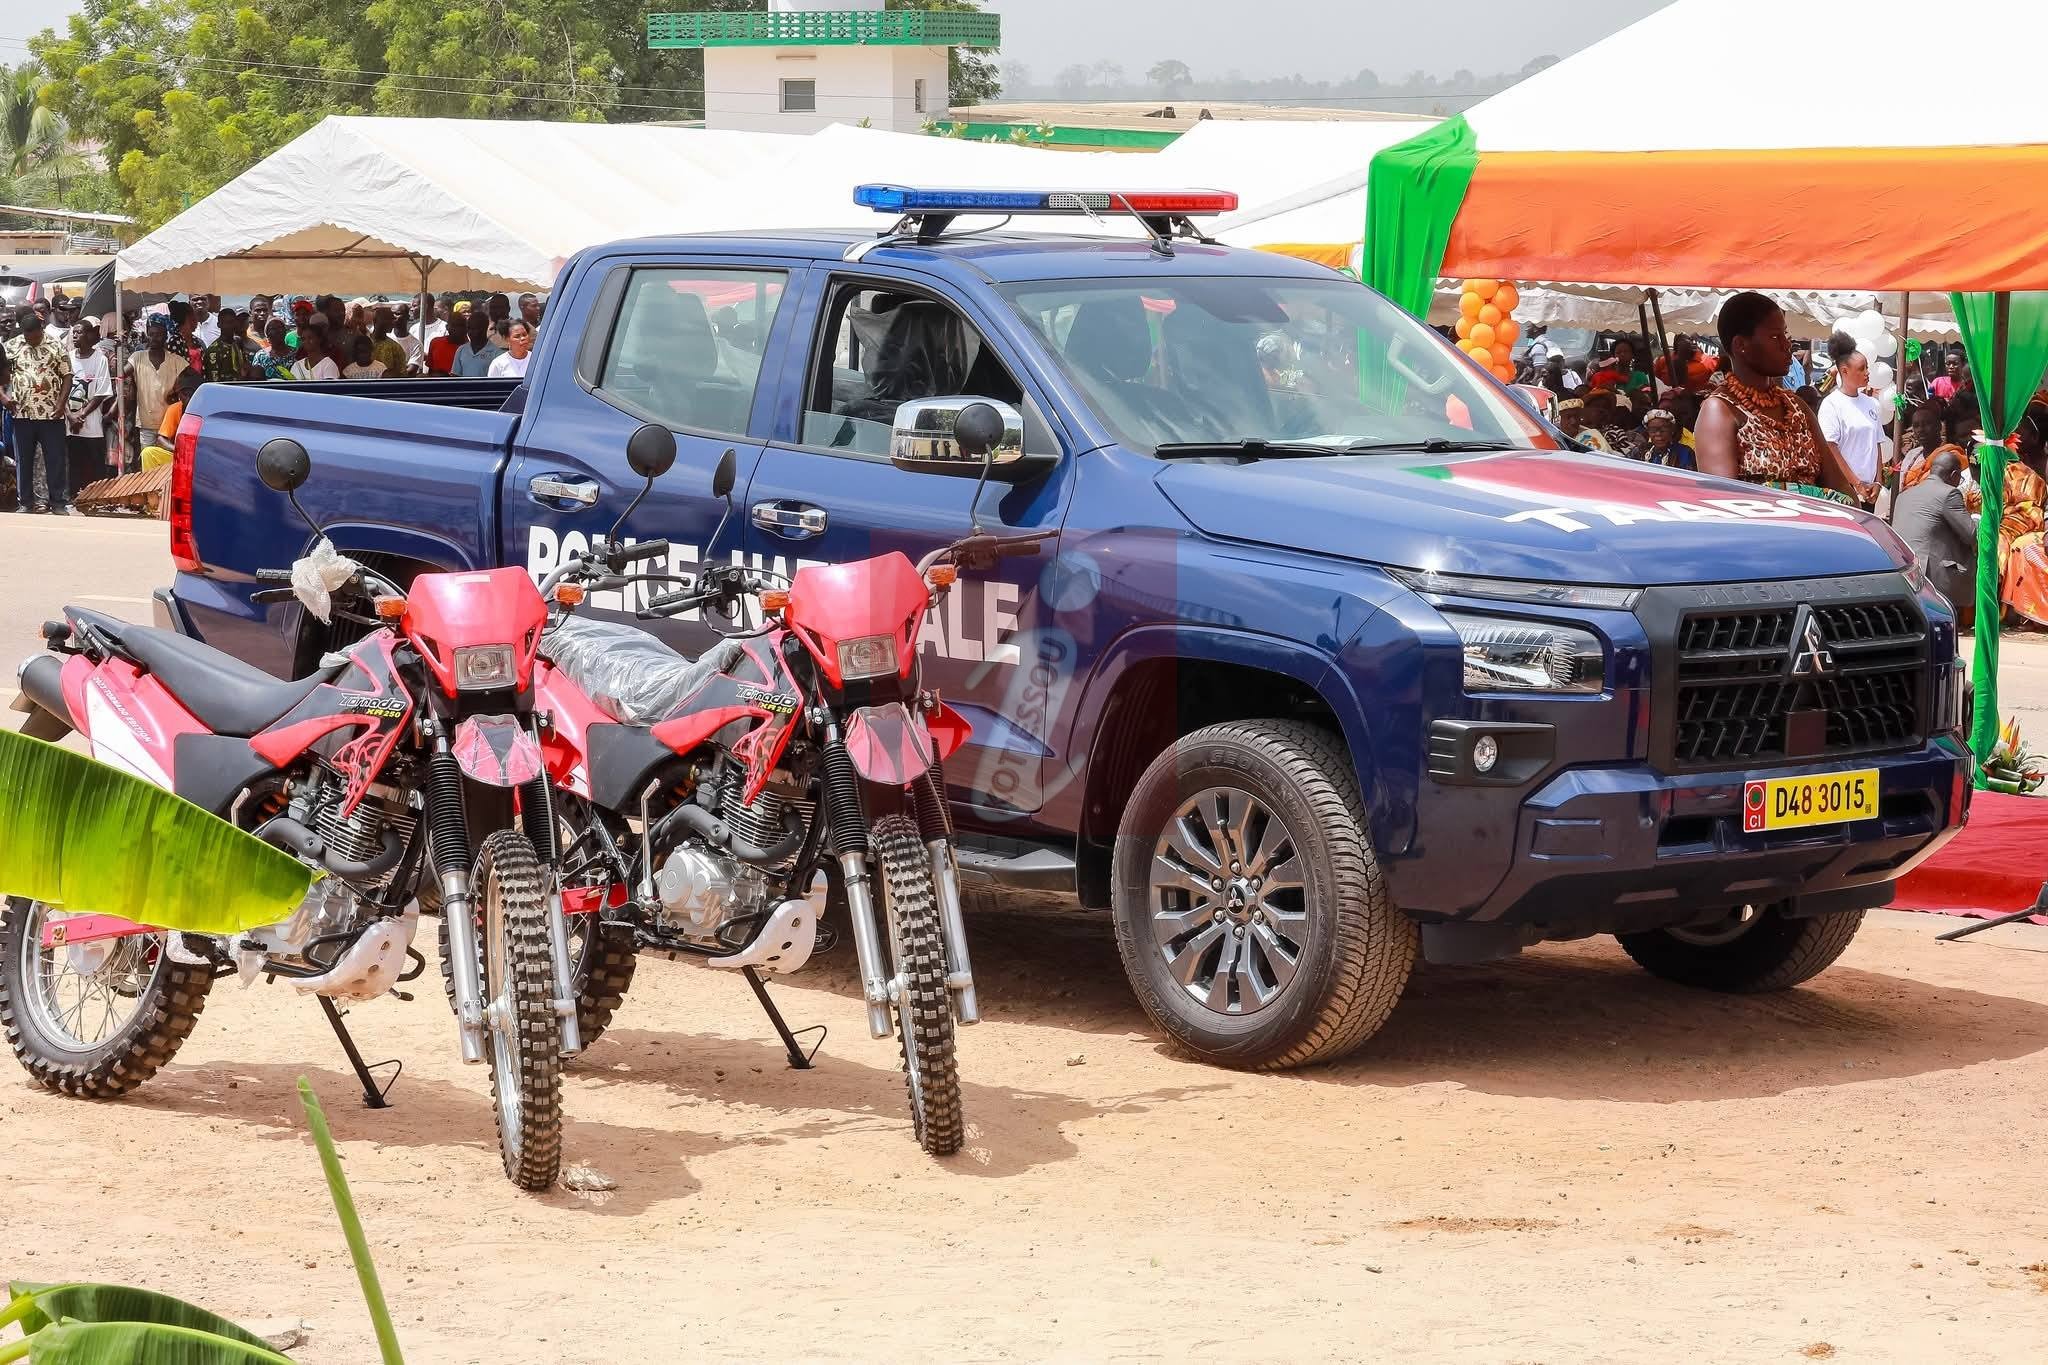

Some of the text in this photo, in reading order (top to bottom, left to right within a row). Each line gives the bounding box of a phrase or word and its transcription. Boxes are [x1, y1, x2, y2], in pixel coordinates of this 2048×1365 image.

[1690, 578, 1889, 606] MITSUBISHI
[337, 692, 407, 712] Tornado
[736, 683, 797, 708] Tornado
[1749, 814, 1761, 829] CI
